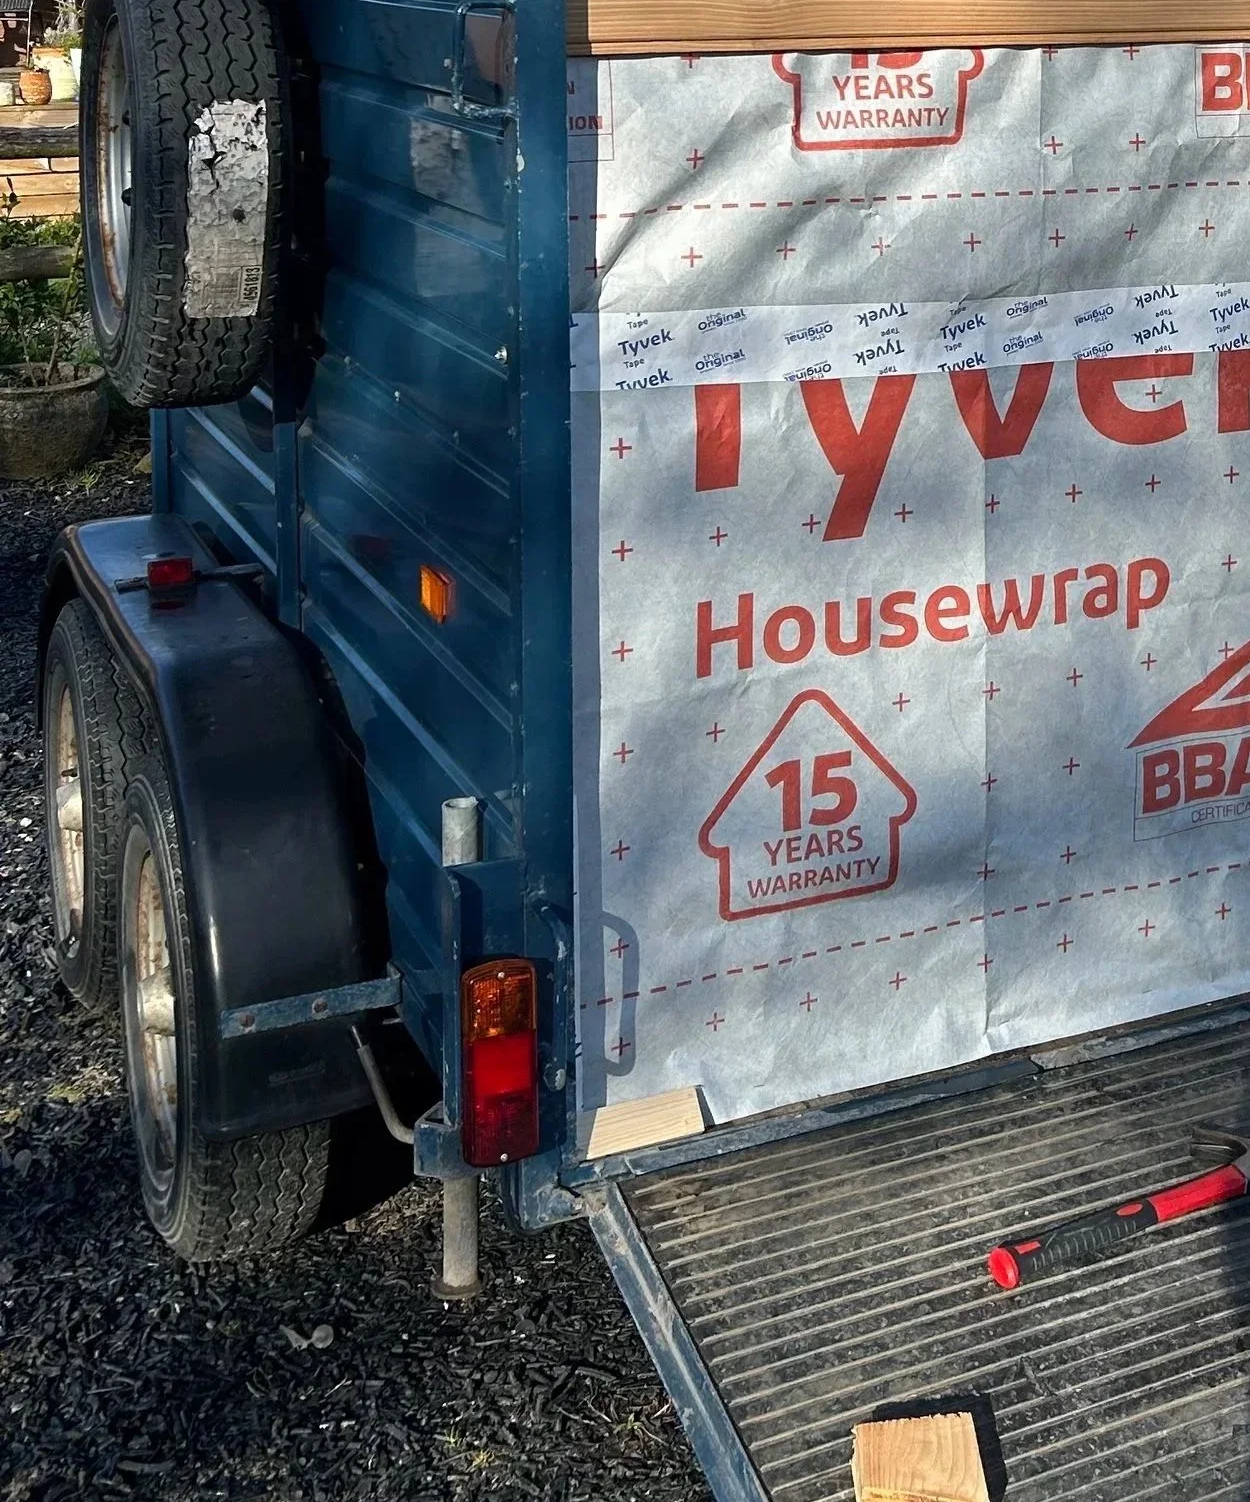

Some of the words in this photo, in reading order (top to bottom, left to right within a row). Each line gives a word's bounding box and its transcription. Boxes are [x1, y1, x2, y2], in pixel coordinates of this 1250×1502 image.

[832, 73, 934, 101] YEARS
[816, 107, 950, 130] WARRANTY
[1006, 297, 1048, 317] Original
[1134, 285, 1179, 308] Tyvek
[698, 308, 747, 331] Original
[856, 302, 908, 327] Tyvek
[1074, 306, 1114, 326] Original
[1209, 297, 1250, 322] Tyvek
[627, 318, 649, 329] Tape
[785, 323, 833, 345] Original
[940, 314, 986, 341] Tyvek
[1132, 319, 1179, 345] Tyvek
[618, 328, 673, 356] Tyvek
[854, 338, 905, 366] Tyvek
[1003, 331, 1043, 354] Original
[623, 357, 645, 369] Tape
[695, 348, 745, 371] Original
[696, 556, 1171, 679] Housewrap
[764, 750, 858, 833] 15
[763, 825, 864, 866] YEARS
[747, 856, 881, 899] WARRANTY
